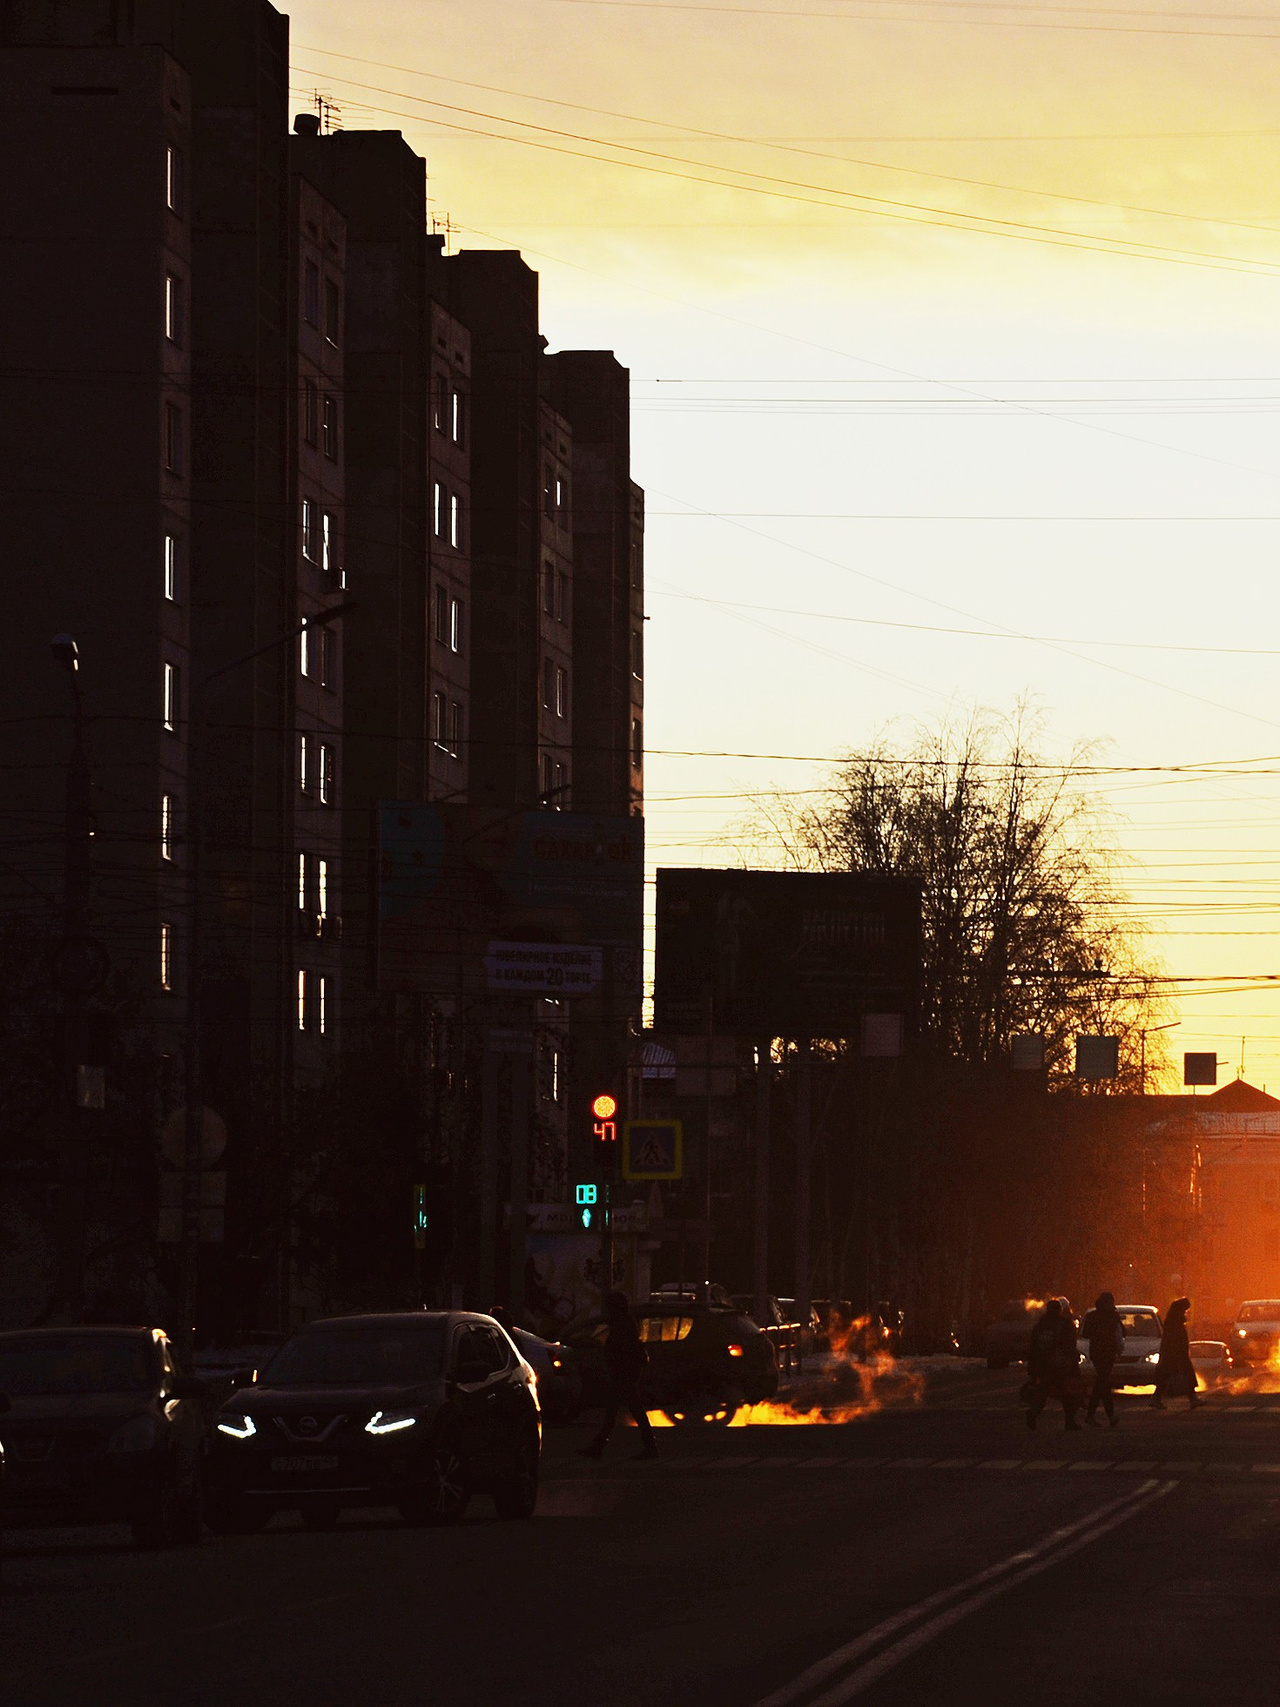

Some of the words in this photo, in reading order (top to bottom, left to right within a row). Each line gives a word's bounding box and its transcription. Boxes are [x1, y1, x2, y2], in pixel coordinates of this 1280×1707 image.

[504, 968, 544, 982] КАЖДОМ
[546, 967, 564, 985] 20
[593, 1122, 616, 1142] 47
[576, 1184, 597, 1204] 08
